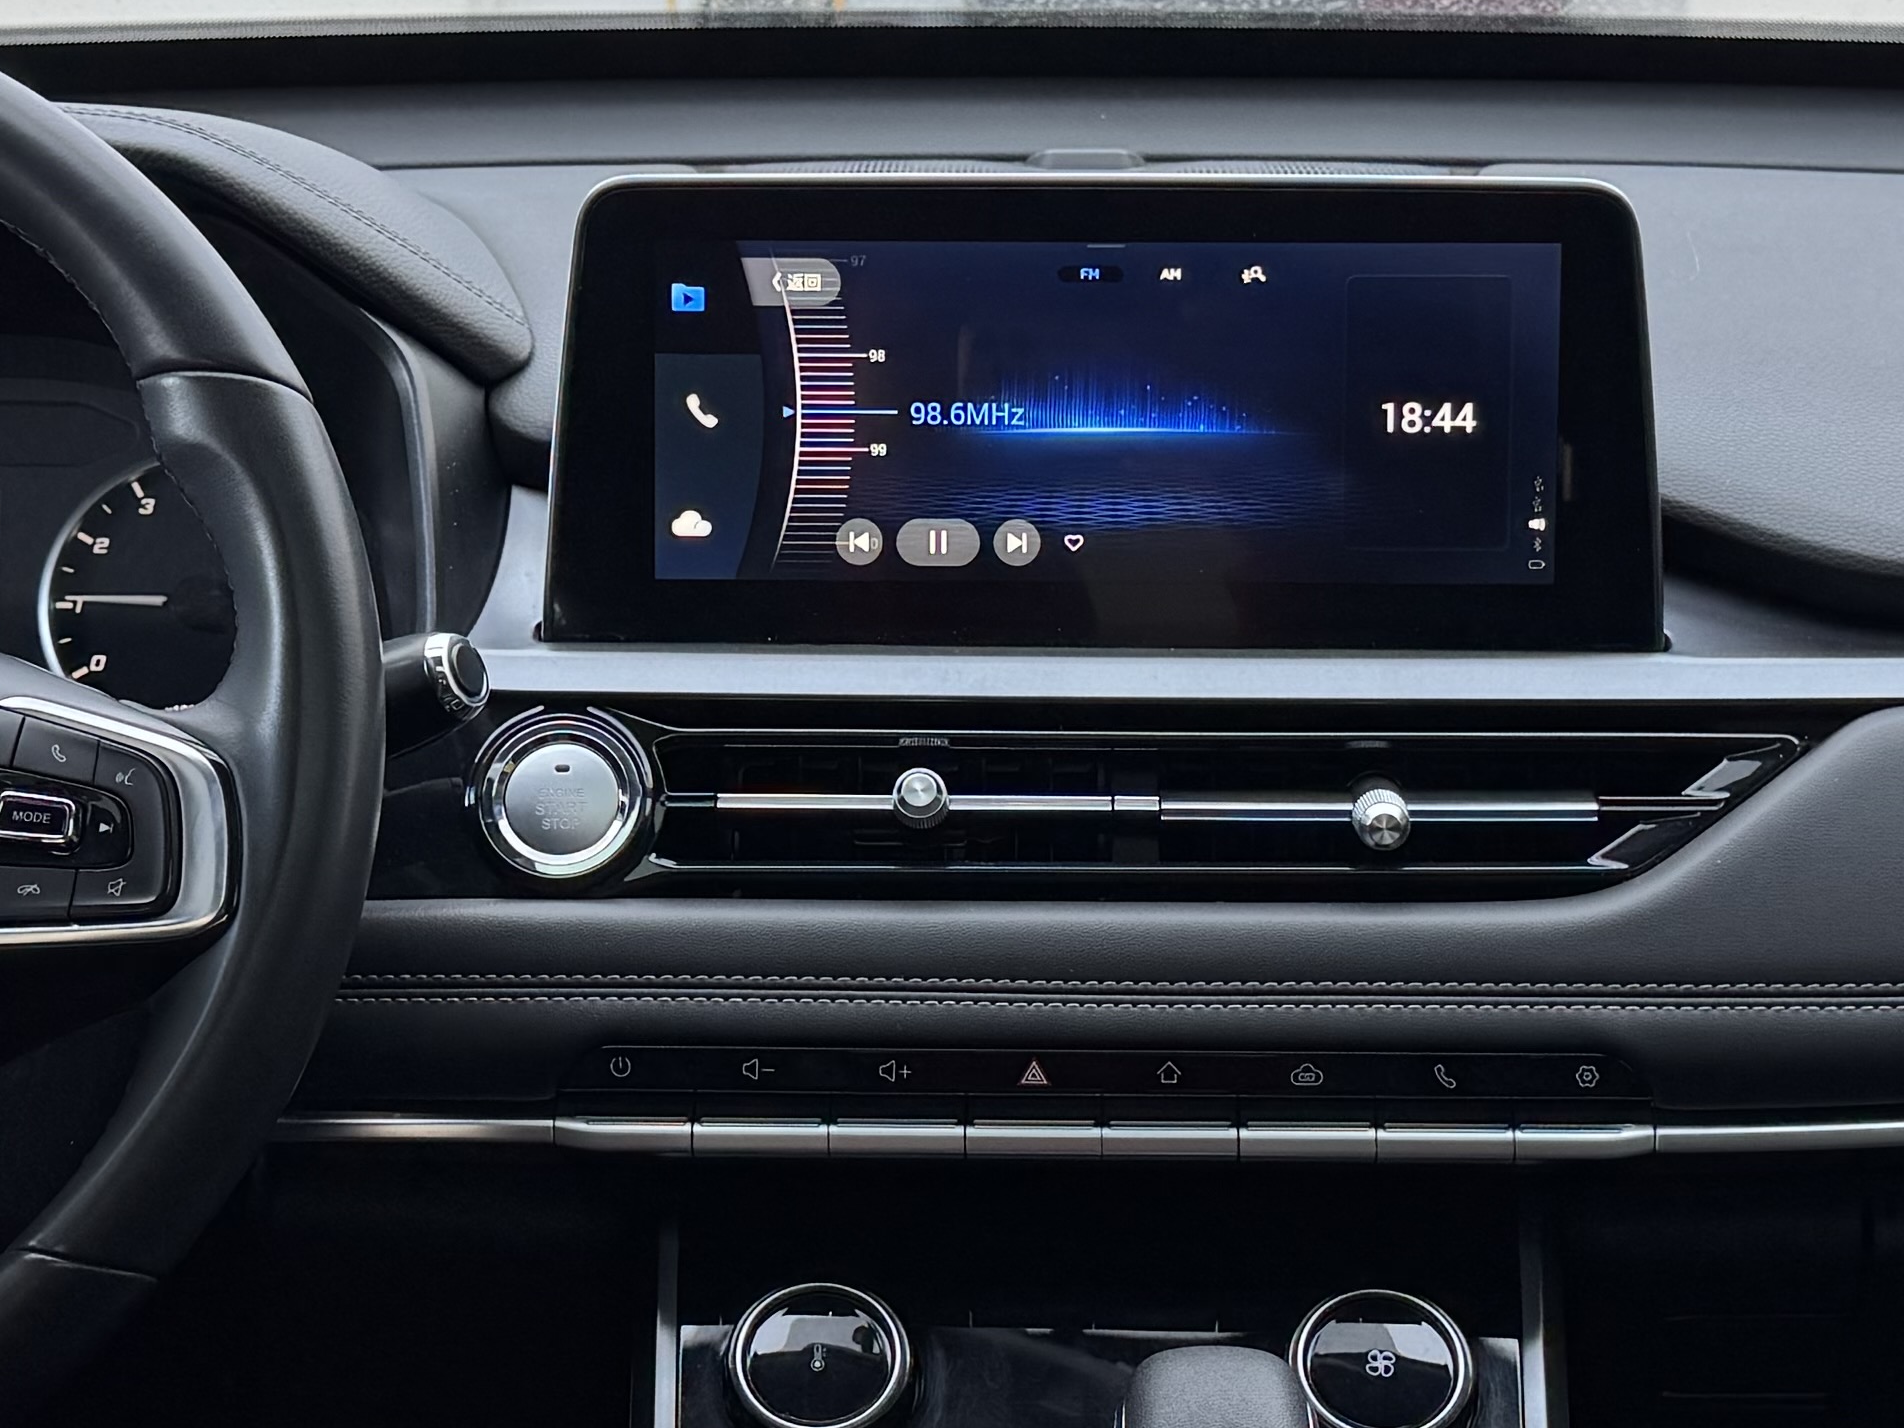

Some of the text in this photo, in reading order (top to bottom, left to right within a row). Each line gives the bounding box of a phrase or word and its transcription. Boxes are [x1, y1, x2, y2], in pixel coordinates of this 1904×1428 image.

[1080, 268, 1100, 281] FM
[1160, 268, 1182, 281] AM
[786, 273, 822, 291] 返回
[868, 349, 886, 363] 98
[909, 402, 1026, 426] 98.6MHz
[1381, 401, 1477, 434] 18:44
[869, 443, 888, 457] 99
[138, 497, 156, 515] 3
[92, 537, 110, 554] 2
[89, 654, 107, 672] 0
[538, 787, 585, 800] ENGINE
[535, 801, 588, 816] START
[11, 810, 52, 824] MODE
[541, 818, 581, 830] STOP
